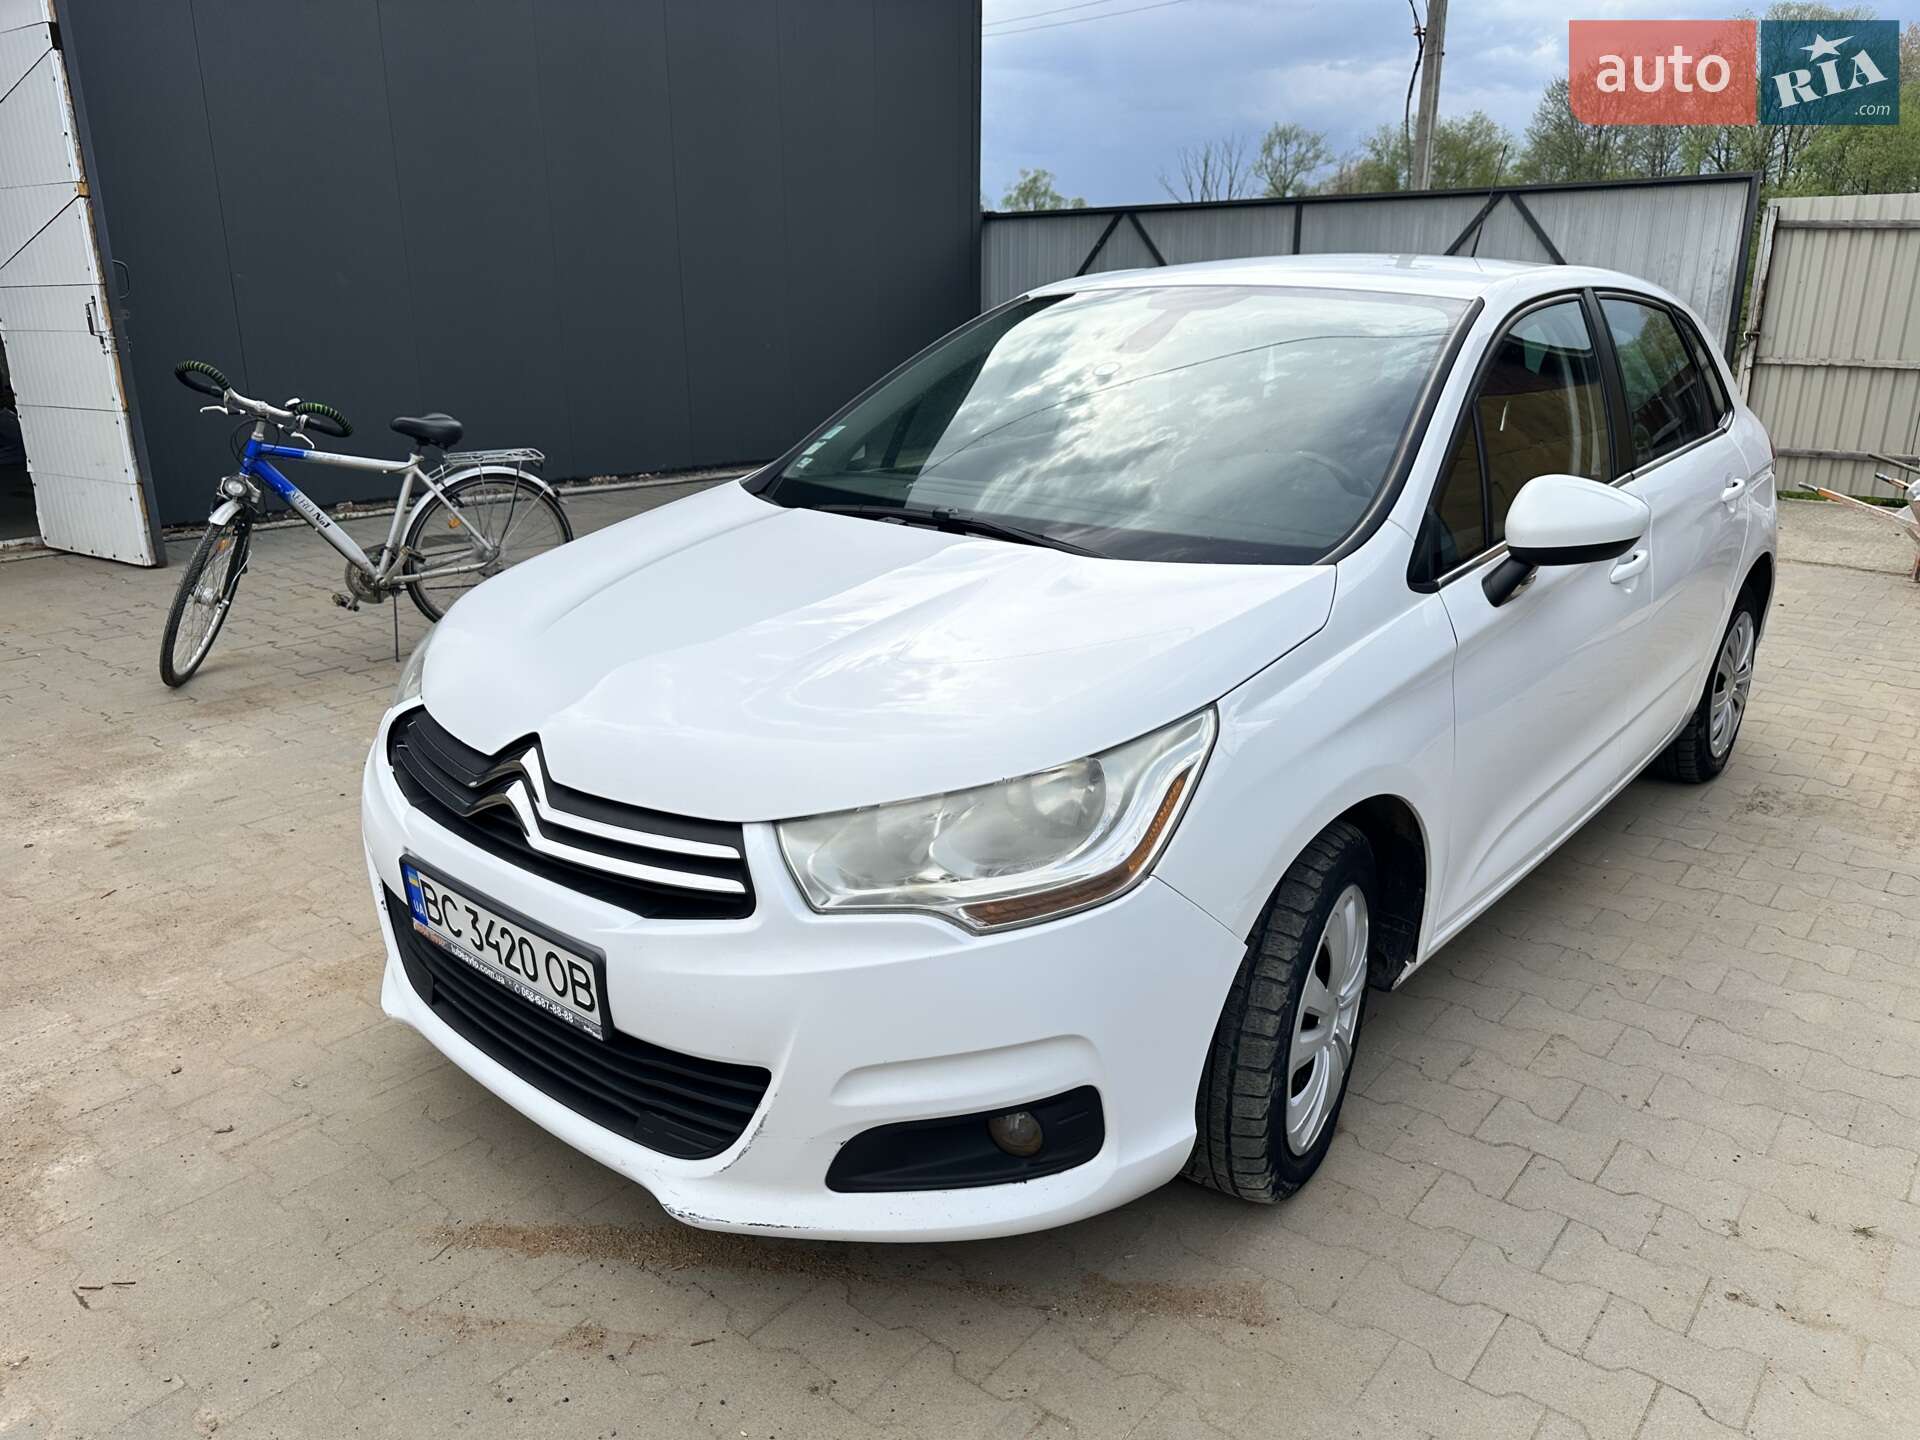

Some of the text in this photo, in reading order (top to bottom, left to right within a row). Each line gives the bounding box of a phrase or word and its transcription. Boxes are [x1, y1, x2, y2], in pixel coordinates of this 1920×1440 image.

[414, 900, 426, 916] UA
[420, 879, 462, 938] BC
[464, 905, 538, 982] 3420
[545, 951, 596, 1013] OB
